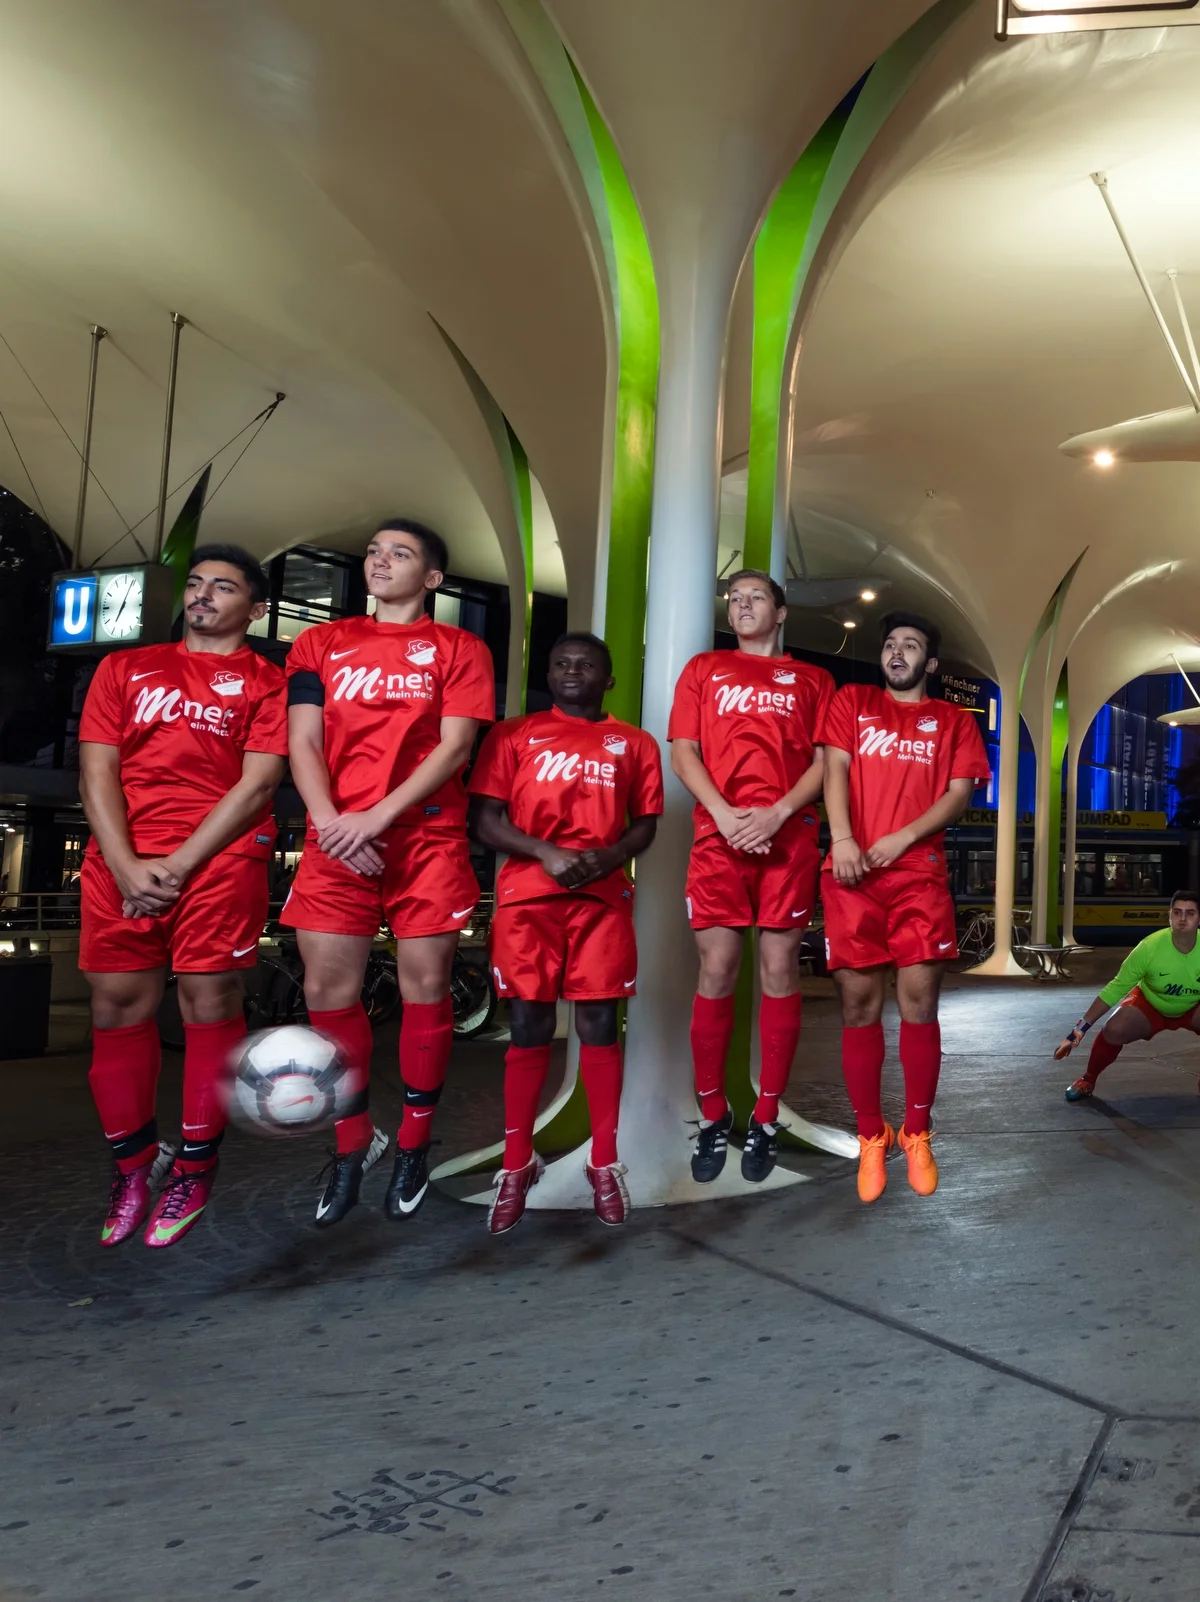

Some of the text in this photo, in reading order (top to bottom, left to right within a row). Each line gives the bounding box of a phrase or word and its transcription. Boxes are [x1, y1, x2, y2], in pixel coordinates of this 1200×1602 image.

[64, 587, 90, 635] U
[412, 642, 426, 653] FC
[218, 673, 235, 684] FC
[386, 690, 411, 699] Mein
[189, 721, 206, 731] ein
